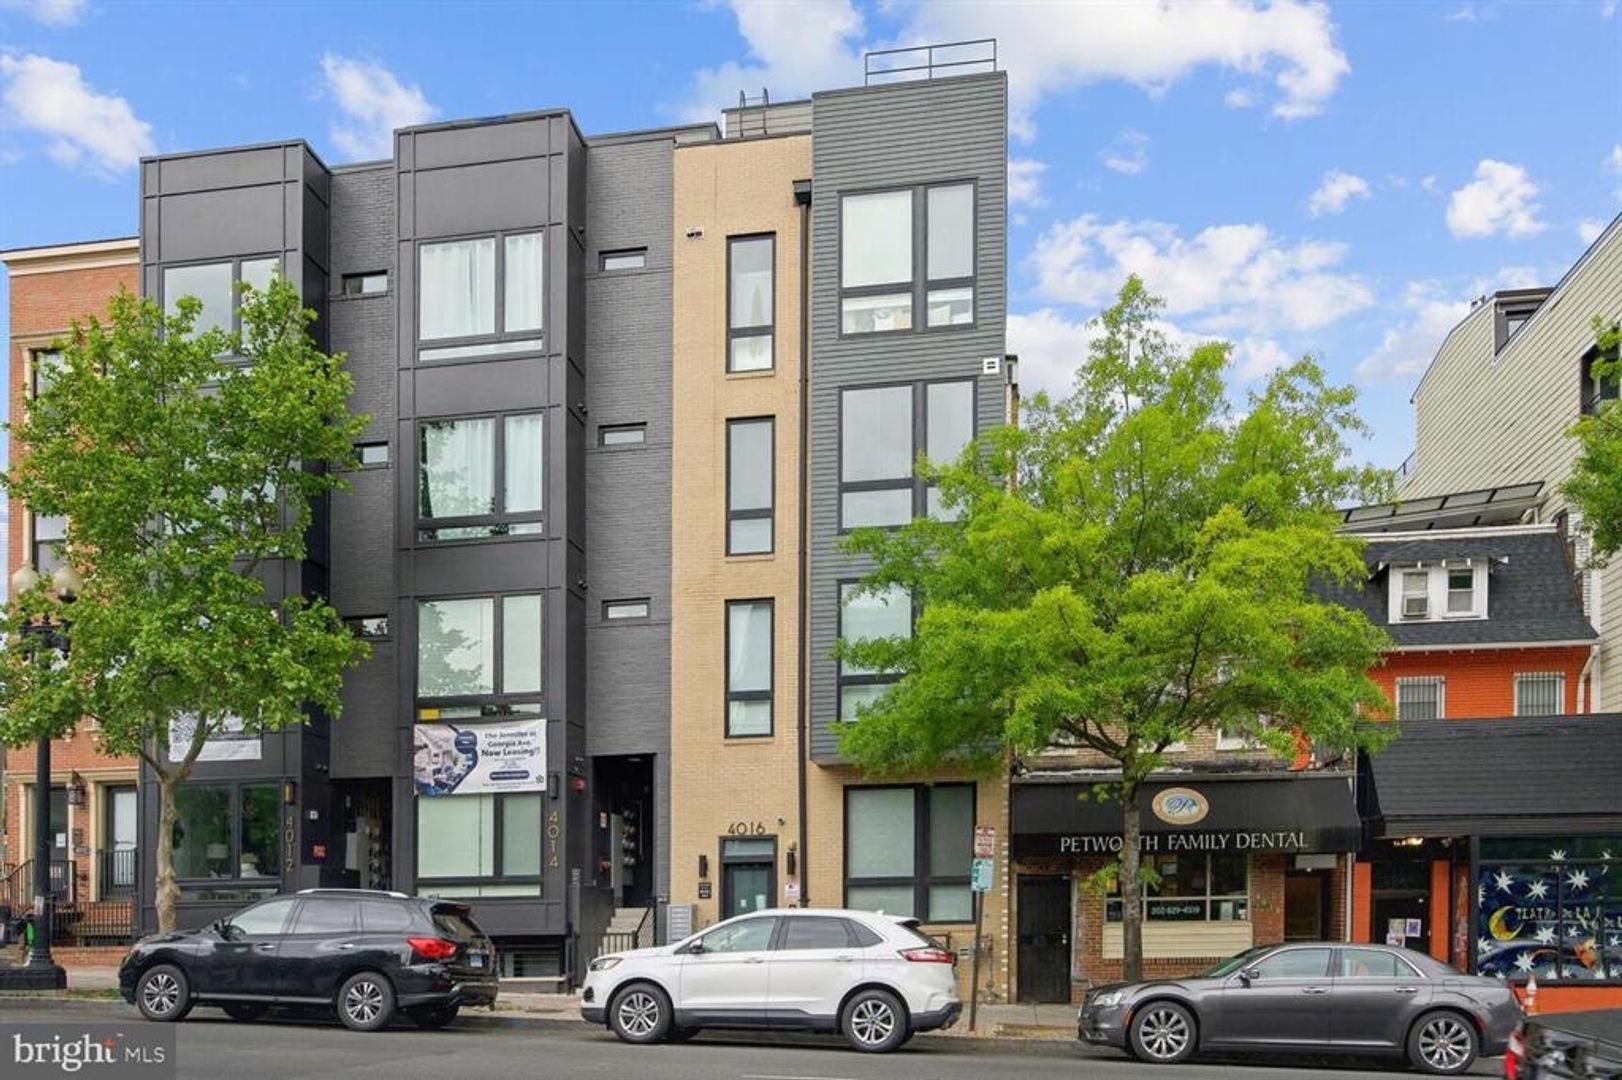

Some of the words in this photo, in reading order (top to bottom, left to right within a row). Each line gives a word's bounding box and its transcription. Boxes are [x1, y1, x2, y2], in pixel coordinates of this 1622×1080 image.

[481, 749, 501, 757] Now
[727, 822, 765, 835] 4016
[285, 816, 294, 873] 4012
[548, 811, 559, 867] 4014
[1060, 835, 1159, 852] PETWOTH
[1167, 834, 1230, 850] FAMILY
[1235, 832, 1308, 849] DENTAL
